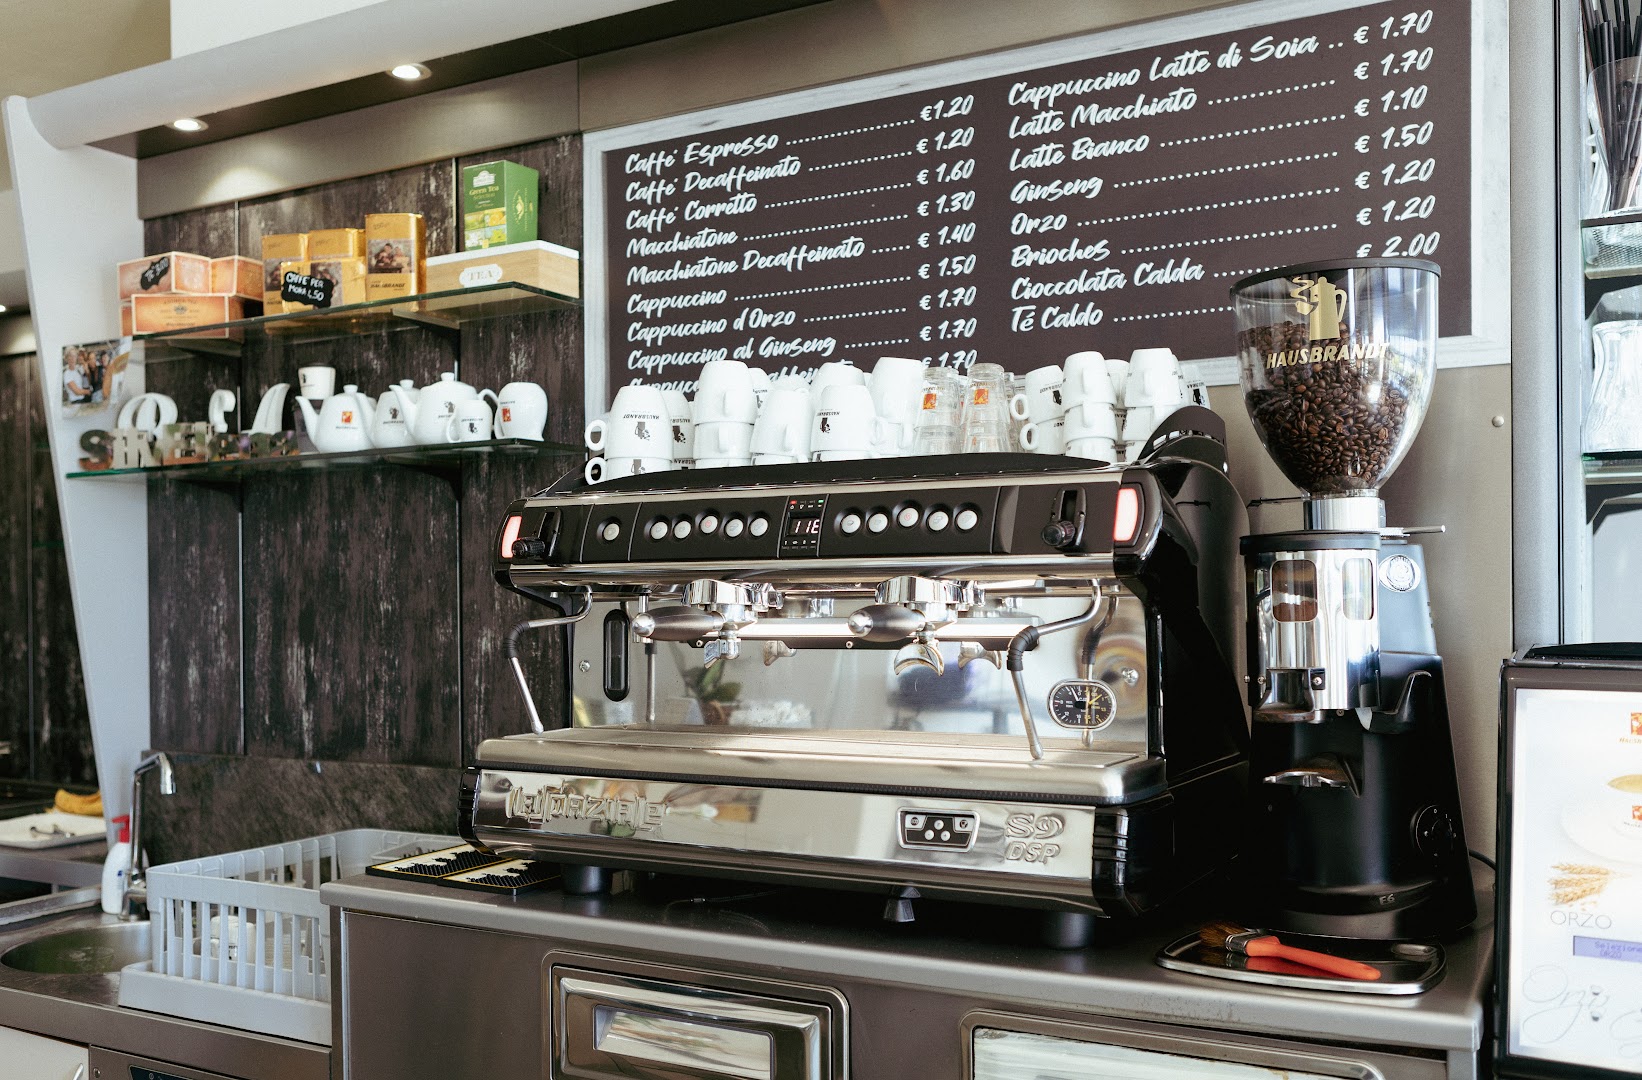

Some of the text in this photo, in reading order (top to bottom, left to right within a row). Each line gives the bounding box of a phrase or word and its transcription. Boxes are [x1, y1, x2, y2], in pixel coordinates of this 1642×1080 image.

[1008, 10, 1433, 110] Cappuccino Latte di Soia € 1.70
[1009, 47, 1433, 139] Latte Macchiato € 1.70
[684, 135, 778, 166] Espresso
[1010, 85, 1428, 171] Latte Bianco € 1.10
[1355, 135, 1370, 153] €
[1381, 121, 1434, 149] 1.50
[684, 155, 801, 192] Decaffeinato
[916, 139, 928, 154] €
[935, 127, 974, 150] 1.20
[685, 192, 757, 220] Corretto
[917, 169, 929, 184] €
[936, 159, 975, 182] 1.60
[627, 191, 975, 258] Macchiatone € 1.30
[1011, 158, 1435, 235] Orzo € 1.20
[627, 222, 976, 286] Macchiatone Decaffeinato € 1.40
[1011, 195, 1436, 267] Brioches € 1.20
[627, 254, 976, 319] Cappuccino € 1.50
[1011, 267, 1127, 300] Cioccolata
[1134, 257, 1205, 286] Calda
[1381, 232, 1440, 257] 2.00
[627, 347, 727, 374] Cappuccino
[733, 338, 754, 359] al
[920, 326, 931, 341] €
[938, 318, 977, 339] 1.70
[628, 319, 727, 347] Cappuccino
[919, 295, 931, 310] €
[938, 286, 976, 308] 1.70
[1012, 302, 1103, 332] Té Caldo
[1266, 343, 1390, 369] HAUSBRANDT
[1005, 813, 1065, 839] S9
[1005, 841, 1060, 864] DSP
[1550, 910, 1612, 929] ORZO
